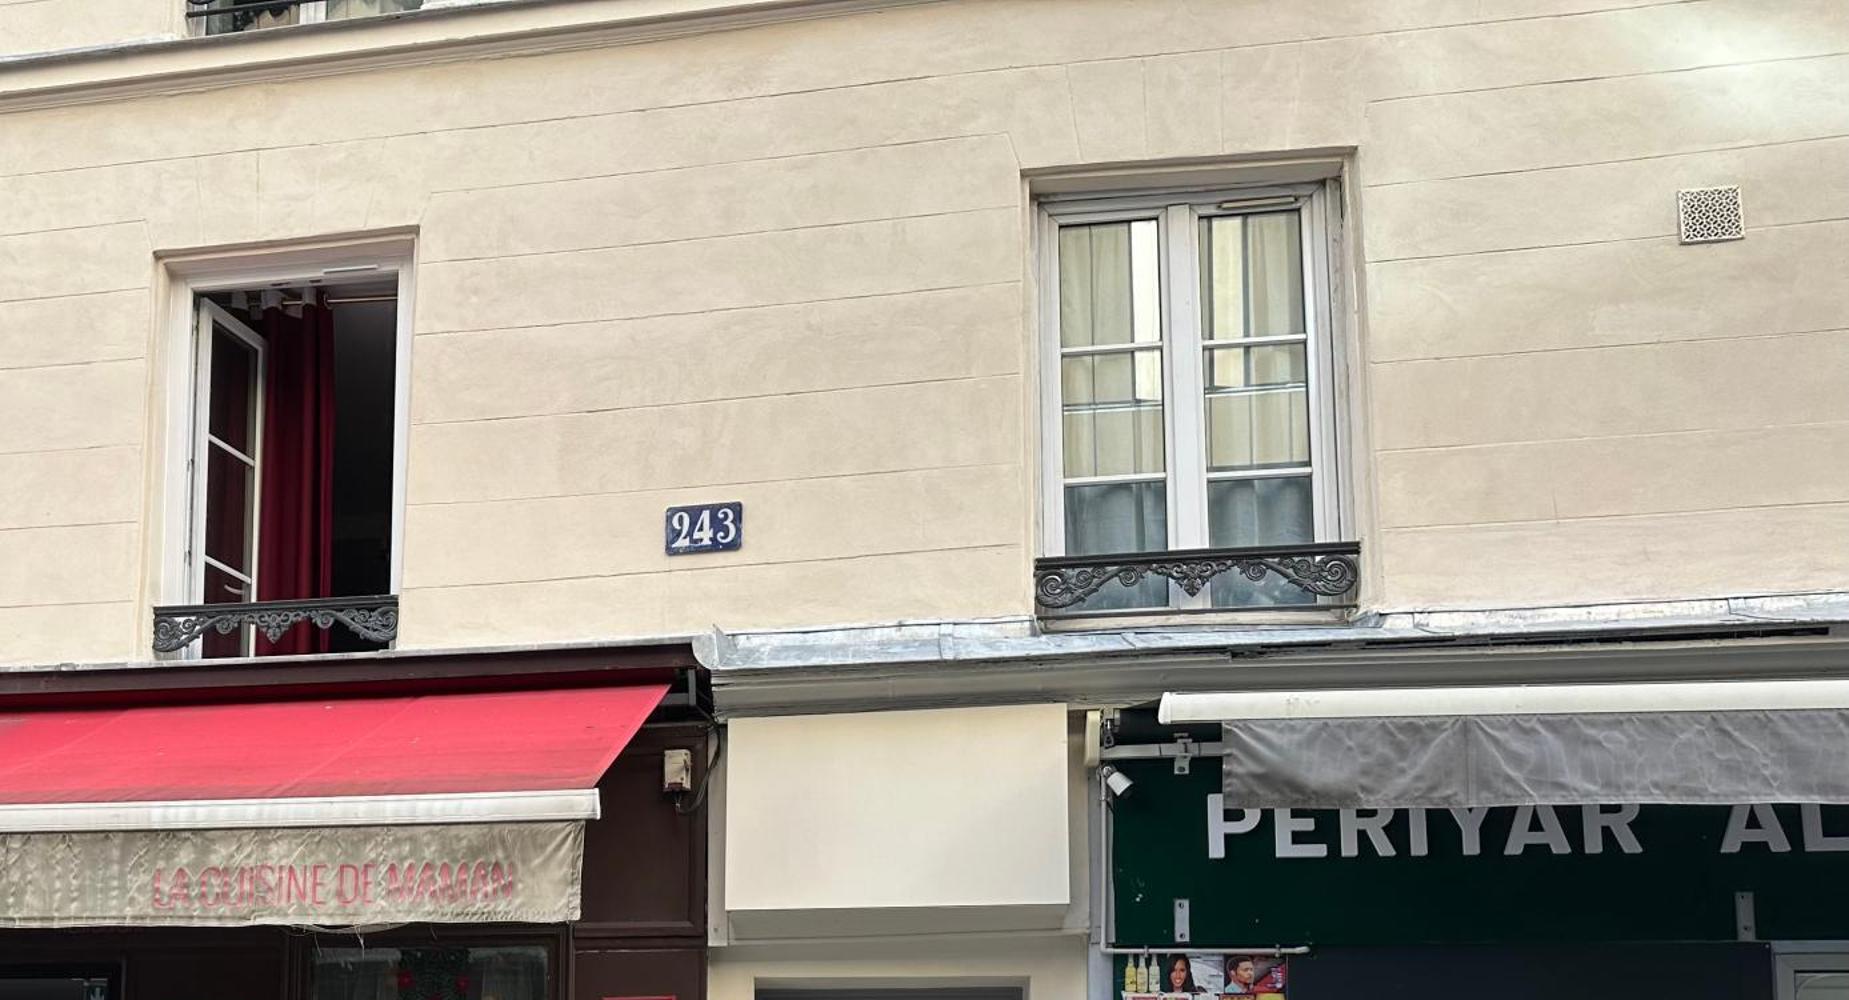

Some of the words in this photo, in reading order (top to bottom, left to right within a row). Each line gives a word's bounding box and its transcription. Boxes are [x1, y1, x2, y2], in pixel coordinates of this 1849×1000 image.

[671, 508, 737, 548] 243
[1207, 793, 1643, 858] PERIYAR
[153, 866, 191, 910] LA
[201, 863, 326, 907] CUISINE
[337, 862, 376, 907] DE
[385, 860, 513, 902] MAMAN
